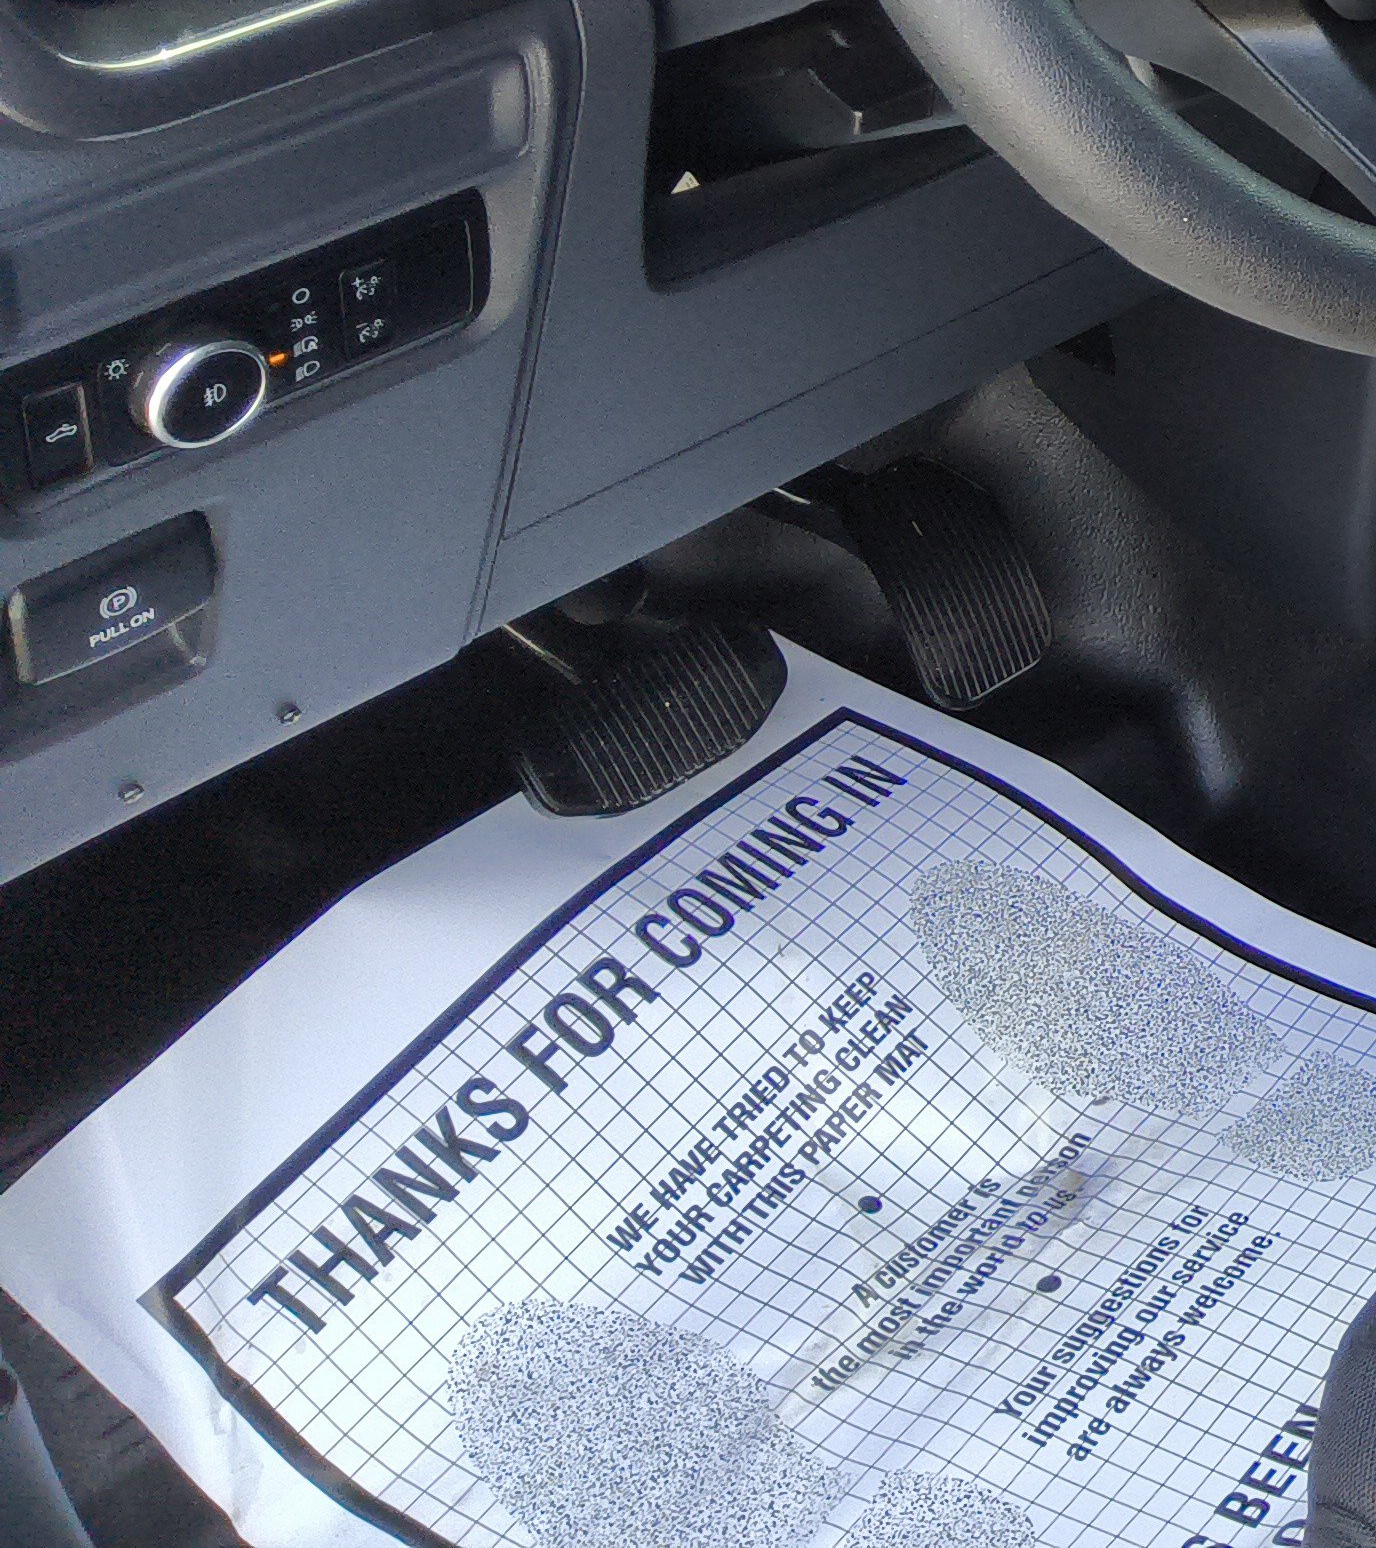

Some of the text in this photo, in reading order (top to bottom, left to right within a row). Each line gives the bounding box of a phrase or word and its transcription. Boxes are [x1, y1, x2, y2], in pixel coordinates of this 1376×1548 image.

[89, 608, 155, 647] PULL ON
[247, 755, 907, 1335] THANKS FOR COMING IN
[606, 972, 878, 1252] WE HAVE TRIED TO KEEP
[635, 993, 914, 1276] YOUR CARPETING CLEAN
[679, 1027, 929, 1285] WITH THIS PAPER MAT
[811, 1353, 861, 1392] the
[857, 1297, 921, 1353] most
[910, 1198, 1020, 1297] important
[851, 1177, 1002, 1309] A customer is
[916, 1300, 964, 1337] the
[957, 1233, 1026, 1295] world
[1015, 1211, 1049, 1233] to
[993, 1205, 1209, 1418] Your suggestions for
[1021, 1211, 1250, 1448] improving our service
[1066, 1230, 1283, 1462] are always welcome.
